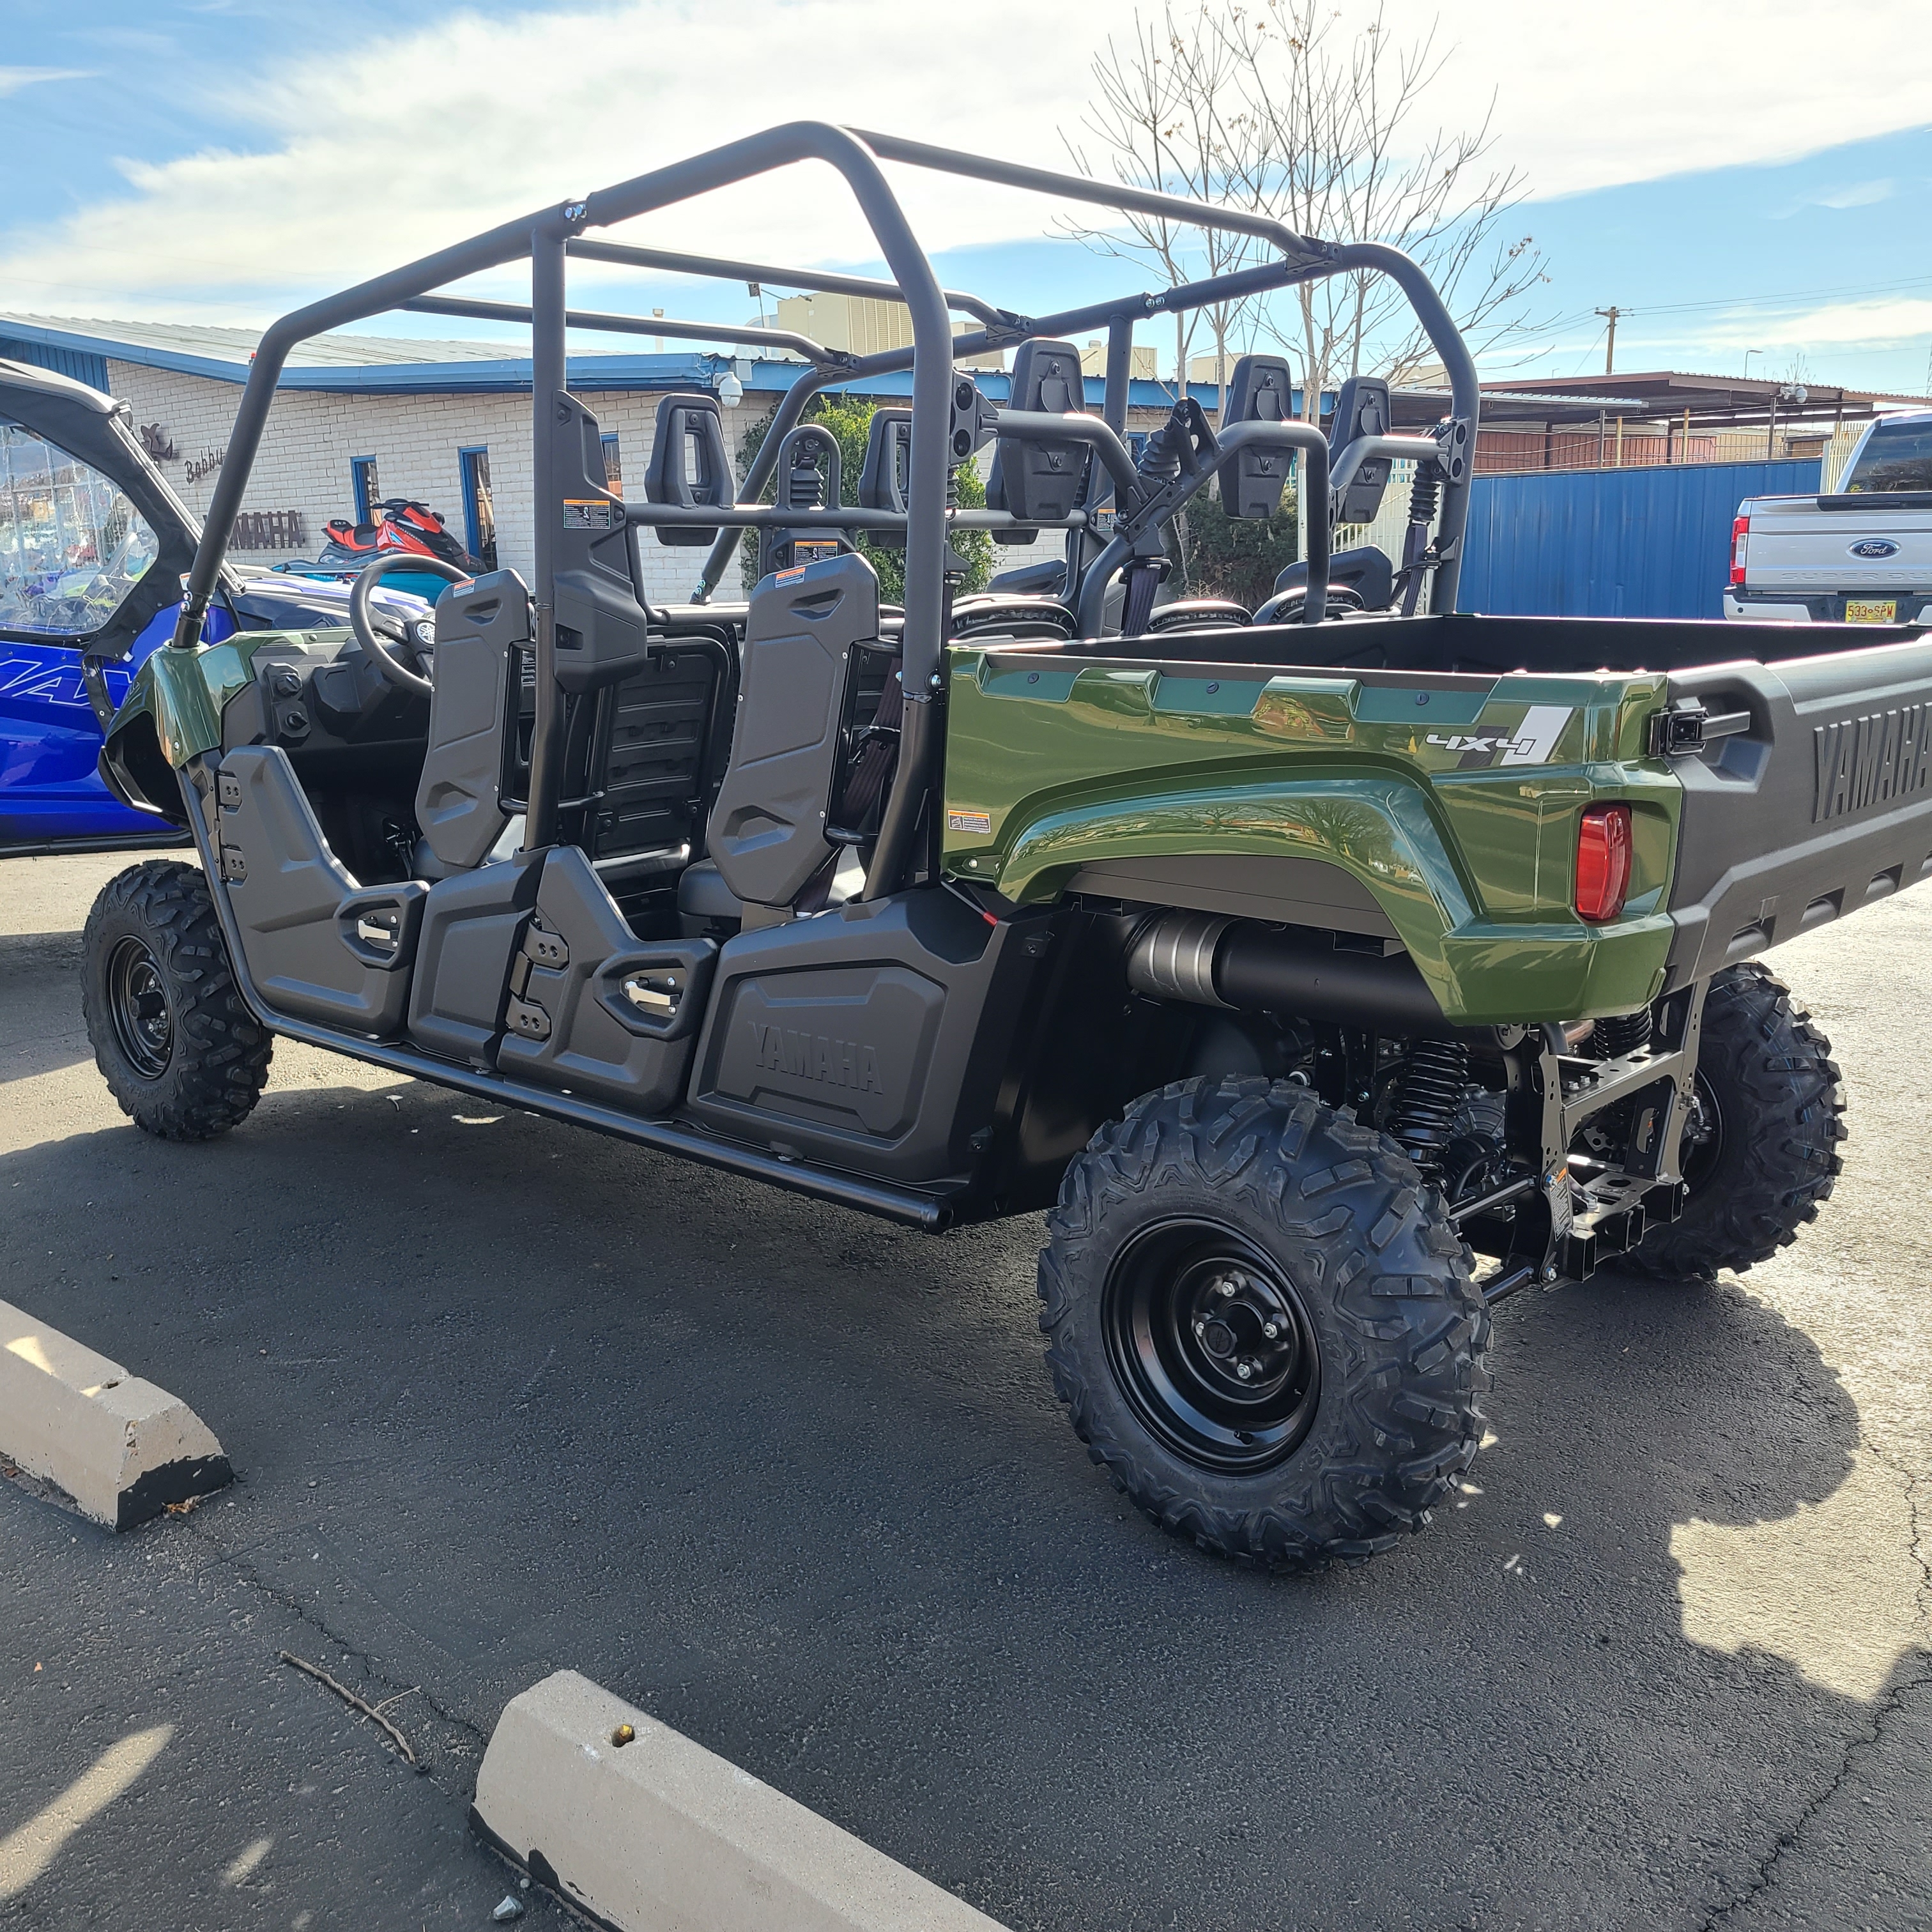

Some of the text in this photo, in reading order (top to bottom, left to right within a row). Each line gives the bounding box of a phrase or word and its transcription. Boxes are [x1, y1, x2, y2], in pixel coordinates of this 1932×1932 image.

[1860, 543, 1888, 555] Ford
[1780, 572, 1932, 581] SUPER DU
[1812, 702, 1932, 824] YAMAHA
[746, 1020, 884, 1095] YAMAHA
